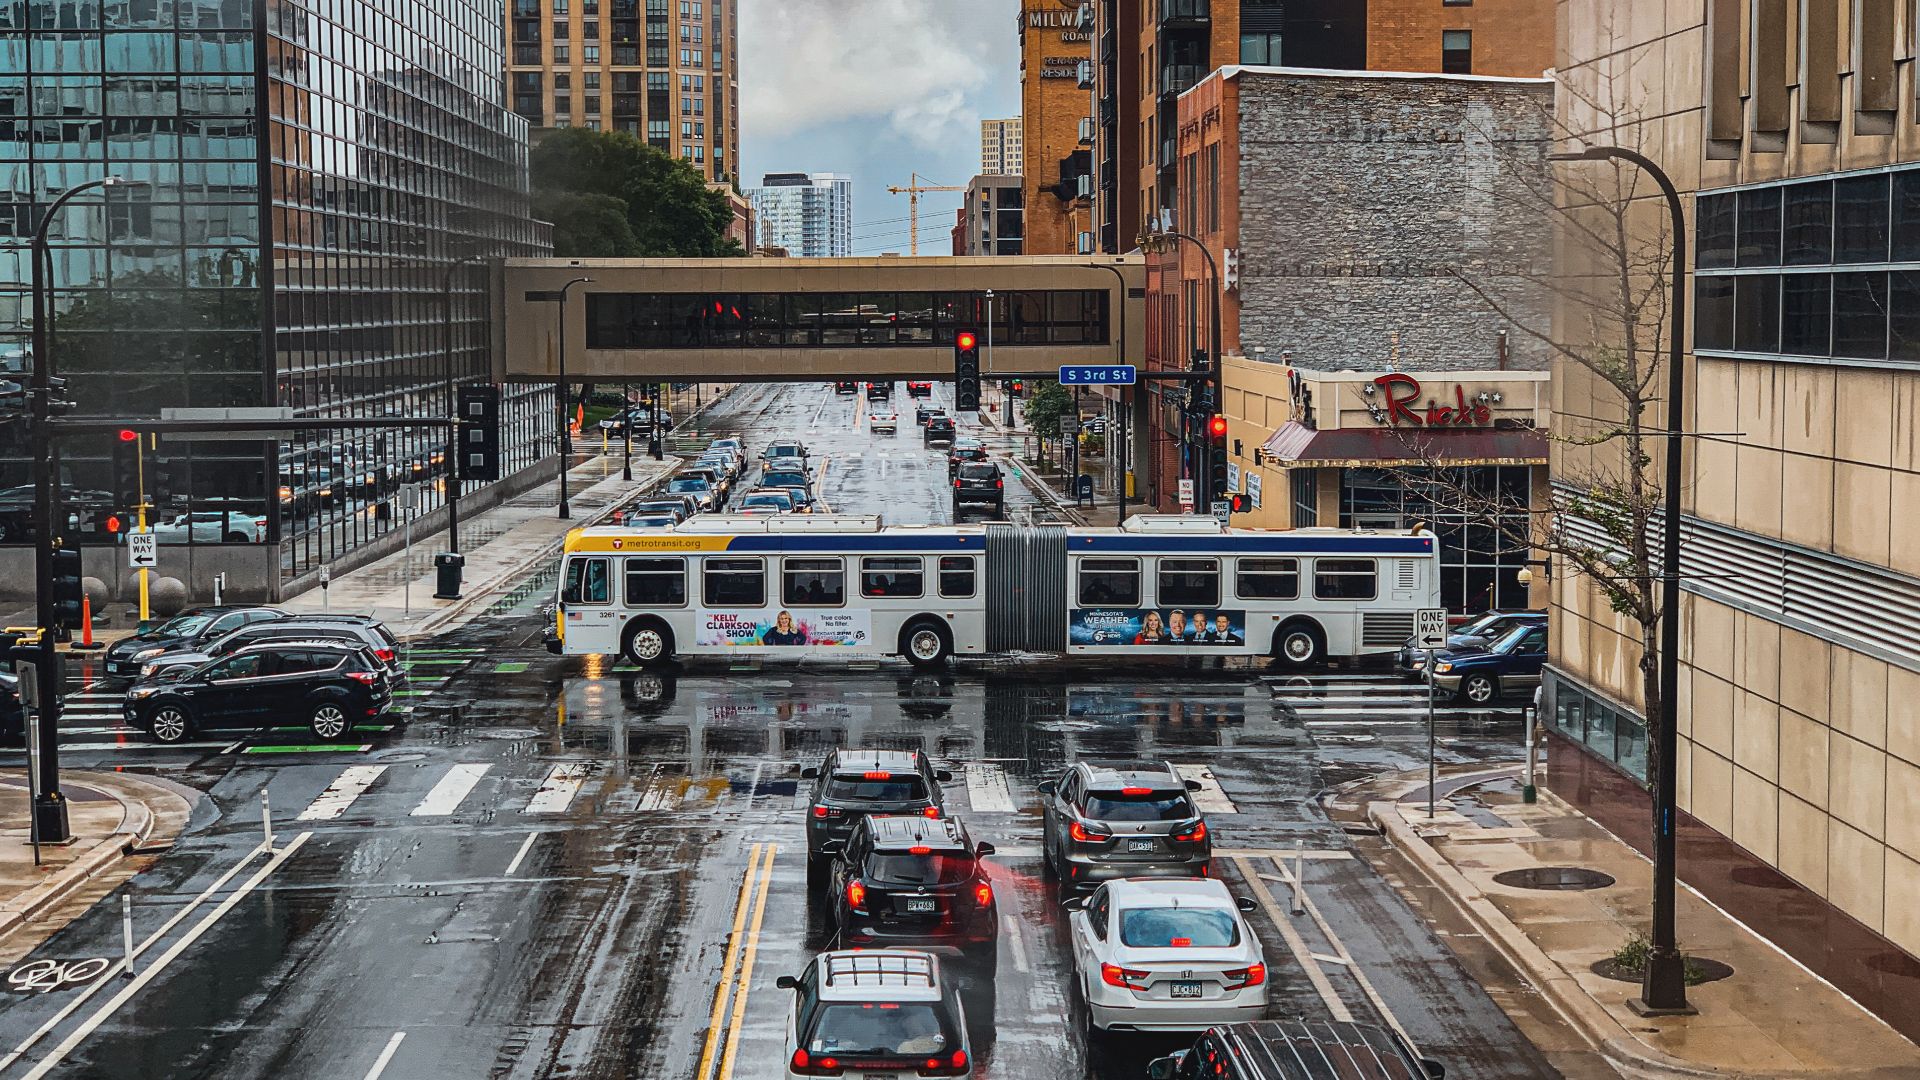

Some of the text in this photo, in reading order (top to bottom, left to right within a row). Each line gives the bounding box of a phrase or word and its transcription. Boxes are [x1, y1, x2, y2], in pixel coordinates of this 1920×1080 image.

[1068, 370, 1127, 380] S 3rd St
[133, 536, 152, 545] ONE
[627, 540, 701, 549] metrotransit.org
[132, 545, 153, 554] WAY
[713, 614, 738, 622] KELLY
[1084, 616, 1129, 624] WEATHER
[1421, 611, 1443, 622] ONE
[706, 622, 757, 630] CLARKSON
[1420, 623, 1444, 633] WAY
[726, 630, 755, 638] SHOW
